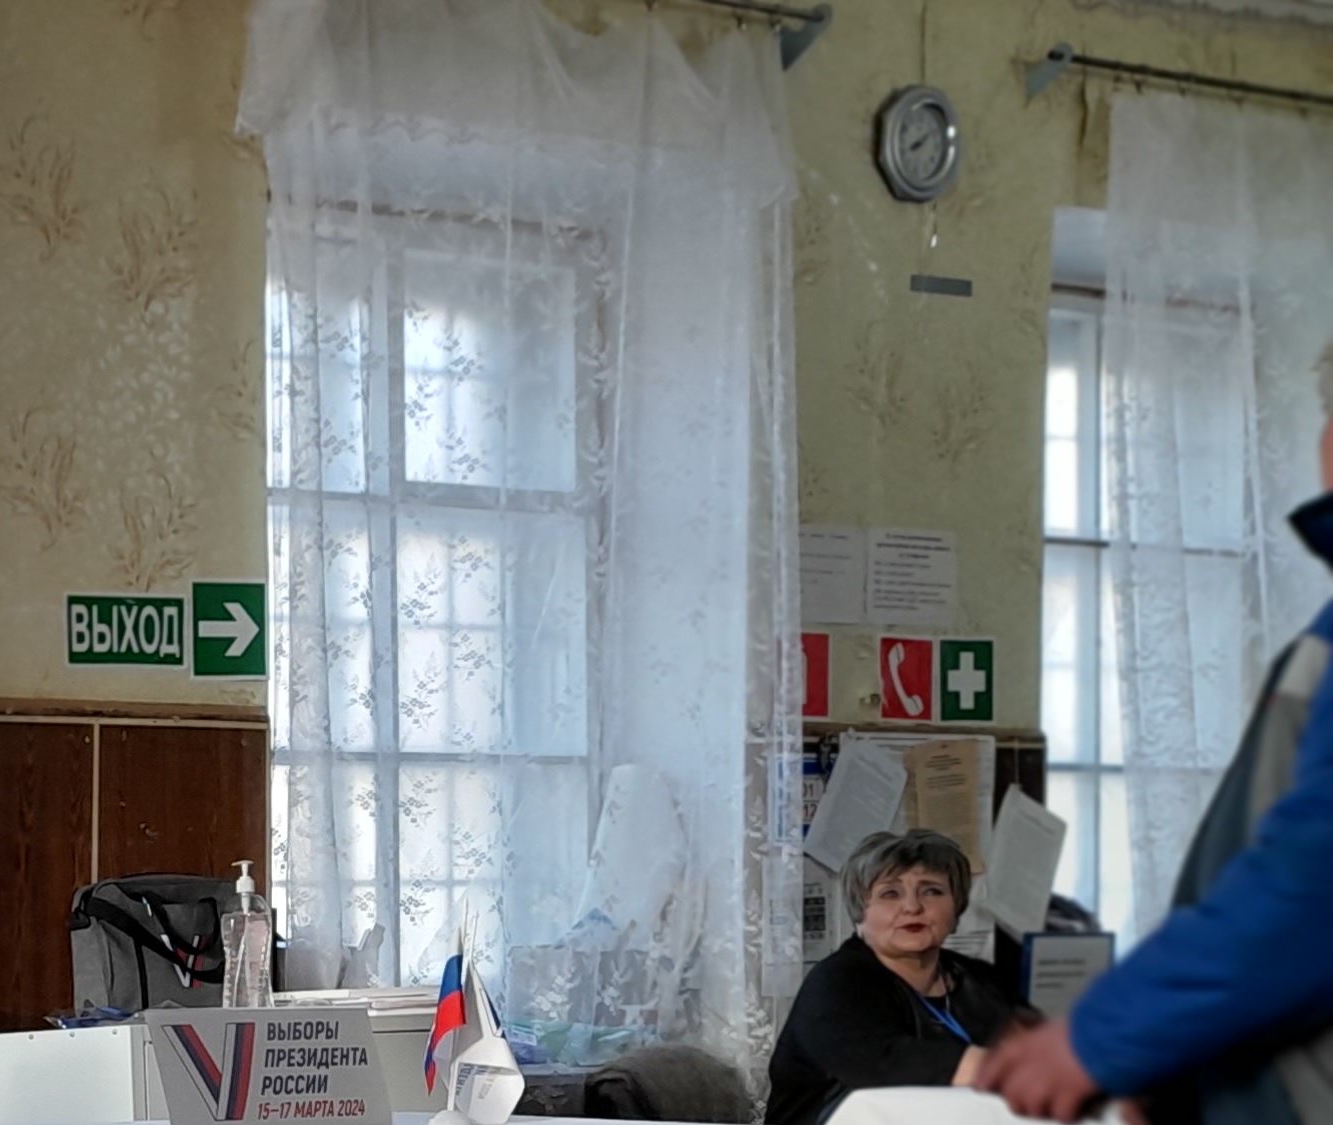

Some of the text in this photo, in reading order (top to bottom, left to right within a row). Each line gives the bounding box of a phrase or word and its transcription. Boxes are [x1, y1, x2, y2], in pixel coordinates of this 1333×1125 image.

[70, 603, 181, 658] ВЫХОД
[267, 1020, 339, 1041] ВЫБОРЫ
[264, 1047, 368, 1069] ПРЕЗИДЕНТА
[261, 1074, 329, 1096] РОССИИ
[293, 1100, 335, 1118] МАРТА
[337, 1099, 365, 1117] 2024
